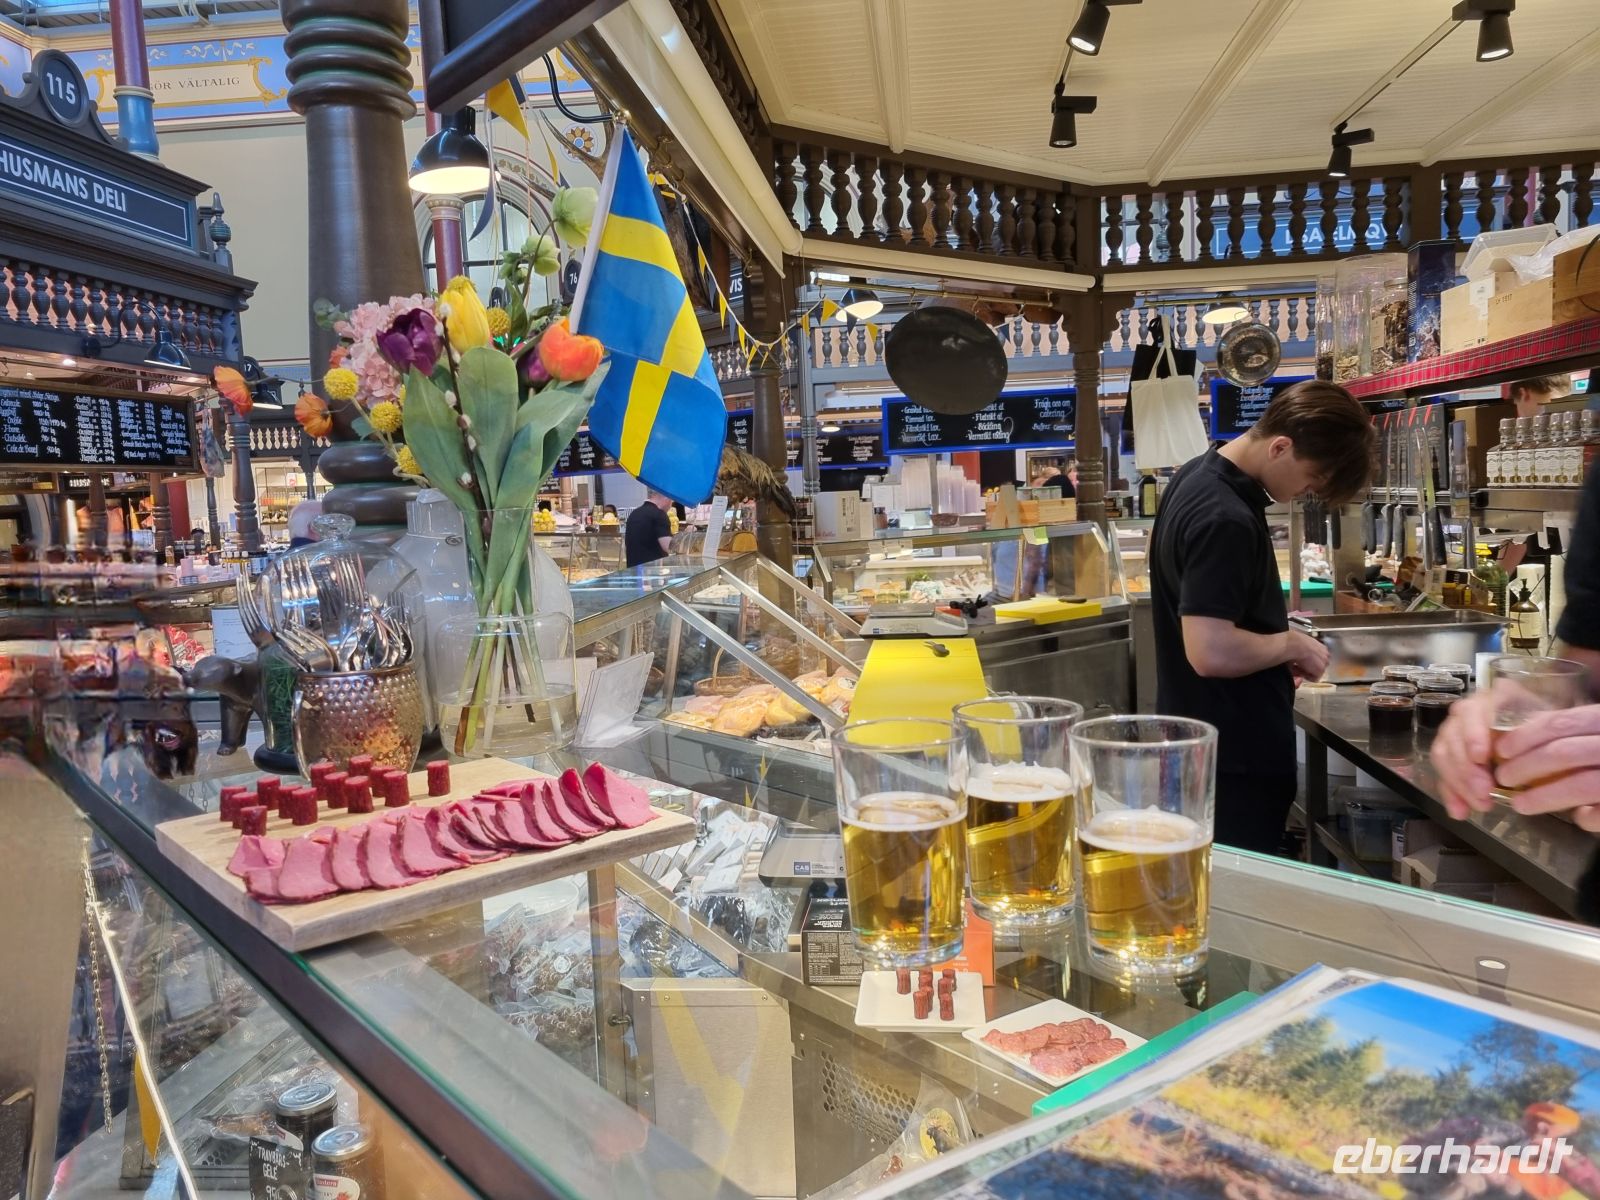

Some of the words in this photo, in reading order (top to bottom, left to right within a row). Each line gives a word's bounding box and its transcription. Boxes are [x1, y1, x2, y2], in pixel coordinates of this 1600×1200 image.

[46, 72, 76, 105] 115
[178, 76, 240, 89] VÄLTALIG
[0, 150, 88, 200] HUSMANS
[93, 182, 127, 212] DELI
